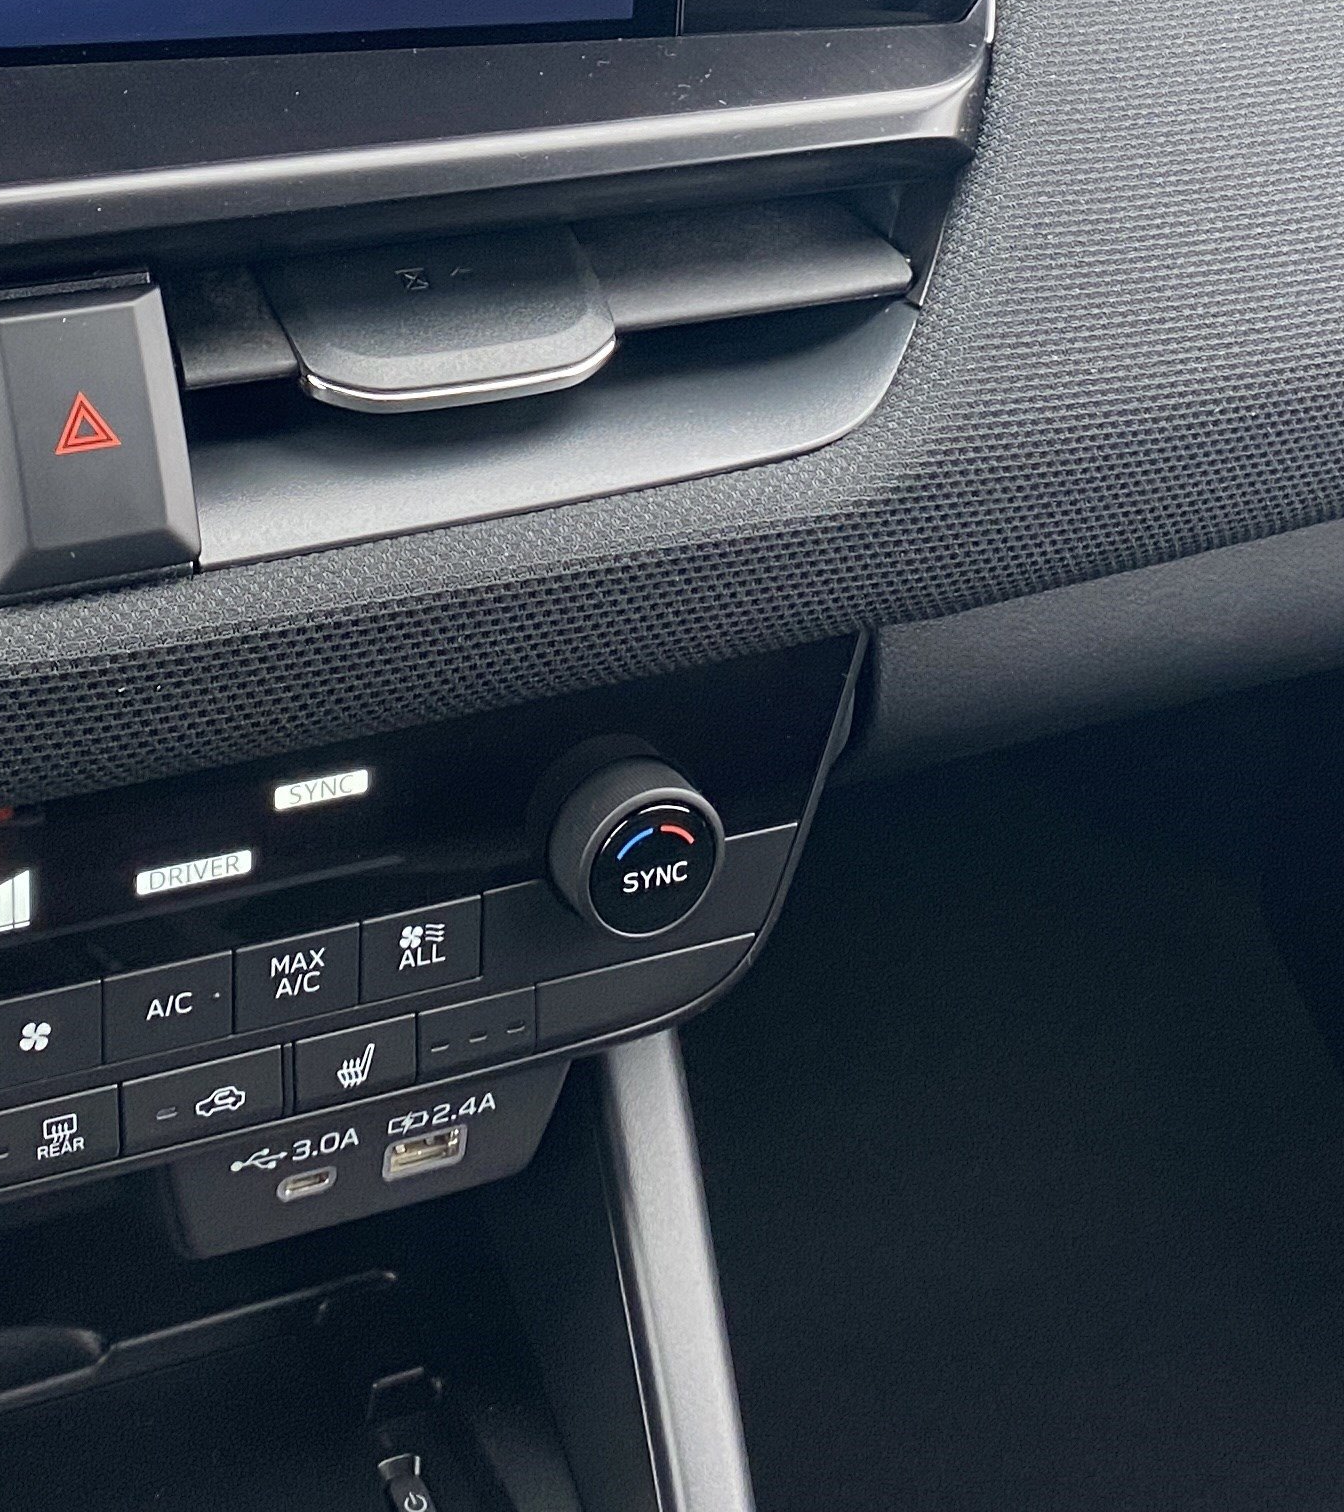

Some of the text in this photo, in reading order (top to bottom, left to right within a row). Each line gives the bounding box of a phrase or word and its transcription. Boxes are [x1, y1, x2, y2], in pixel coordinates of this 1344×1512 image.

[289, 775, 354, 804] SYNC
[148, 855, 241, 890] DRIVER
[622, 860, 688, 893] SYNC
[271, 949, 324, 976] MAX
[398, 947, 445, 971] ALL
[275, 970, 321, 999] A/C
[146, 991, 193, 1021] A/C
[431, 1092, 496, 1125] 2.4A
[37, 1137, 84, 1159] REAR
[292, 1127, 359, 1161] 3.0A
